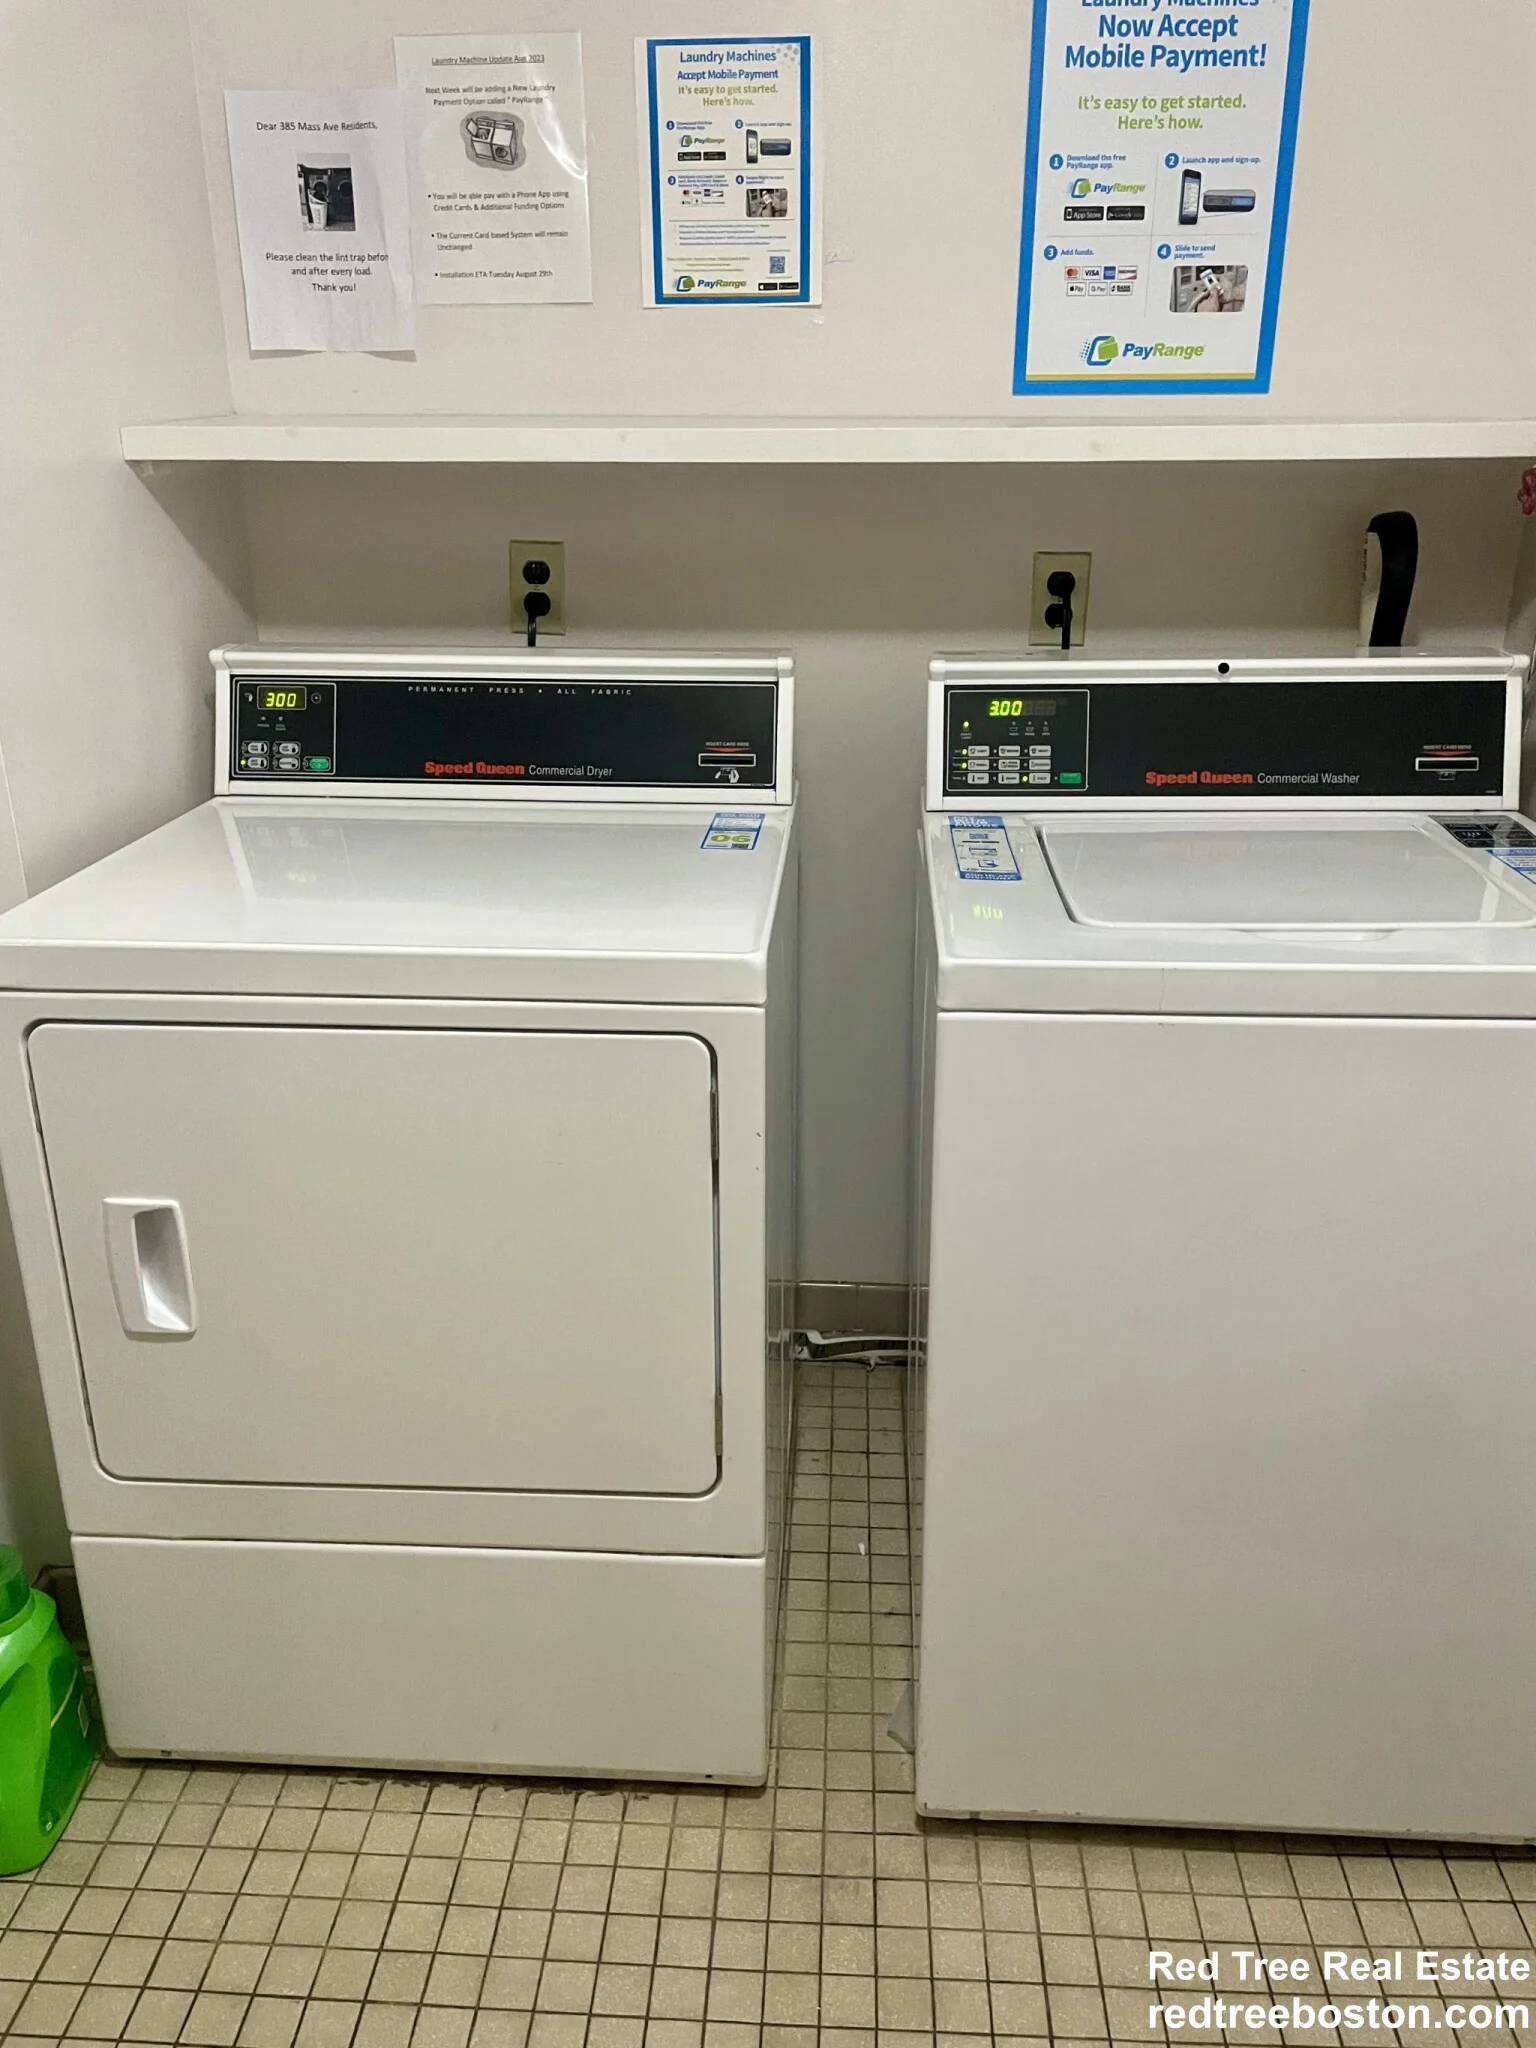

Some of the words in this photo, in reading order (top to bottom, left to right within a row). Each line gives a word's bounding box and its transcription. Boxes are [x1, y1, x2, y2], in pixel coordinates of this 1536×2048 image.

[1099, 14, 1153, 37] Now
[1157, 14, 1239, 42] Accept
[432, 57, 458, 66] Laundry
[460, 56, 487, 64] Machine
[489, 55, 513, 64] Update
[515, 55, 527, 64] Aug
[528, 54, 544, 63] 2023
[680, 51, 724, 64] Laundry
[726, 49, 777, 61] Machines
[1065, 43, 1145, 68] Mobile
[1150, 43, 1267, 73] Payment!
[677, 70, 706, 81] Accept
[708, 69, 737, 79] Mobile
[738, 69, 779, 81] Payment
[485, 85, 506, 94] adding
[530, 84, 556, 92] Laundry
[679, 85, 692, 94] It's
[694, 86, 714, 96] easy
[716, 86, 725, 94] to
[727, 85, 741, 95] get
[743, 84, 779, 93] started.
[512, 96, 543, 104] PayRange
[703, 97, 731, 106] Here's
[733, 97, 755, 106] how.
[1078, 95, 1100, 109] It's
[1104, 98, 1138, 112] easy
[1142, 96, 1157, 108] to
[1160, 97, 1184, 112] get
[1188, 93, 1247, 109] started.
[256, 121, 277, 131] Dear
[280, 121, 296, 131] 385
[298, 122, 321, 131] Mass
[323, 122, 339, 131] Ave
[341, 121, 378, 131] Residents,
[1118, 114, 1164, 129] Here's
[1168, 114, 1203, 129] how.
[1094, 183, 1146, 194] PayRange
[514, 203, 539, 211] Funding
[475, 231, 489, 239] Card
[511, 231, 533, 239] System
[266, 252, 294, 262] Please
[295, 253, 318, 262] clean
[319, 252, 334, 261] the
[335, 252, 349, 262] lint
[350, 253, 366, 263] trap
[291, 267, 307, 276] and
[308, 267, 328, 276] after
[331, 268, 353, 277] every
[355, 267, 373, 276] load.
[489, 271, 514, 279] Tuesday
[516, 271, 537, 279] August
[312, 283, 337, 292] Thank
[339, 283, 357, 293] you!
[697, 279, 747, 289] PayRange
[1122, 343, 1205, 360] PayRange
[266, 693, 297, 707] 300
[424, 762, 473, 776] Speed
[475, 762, 524, 775] Queen
[528, 764, 585, 776] Commercial
[587, 766, 612, 778] Dryer
[1145, 771, 1198, 787] Speed
[1200, 771, 1253, 785] Queen
[1257, 772, 1318, 784] Commercial
[1320, 773, 1360, 784] Washer
